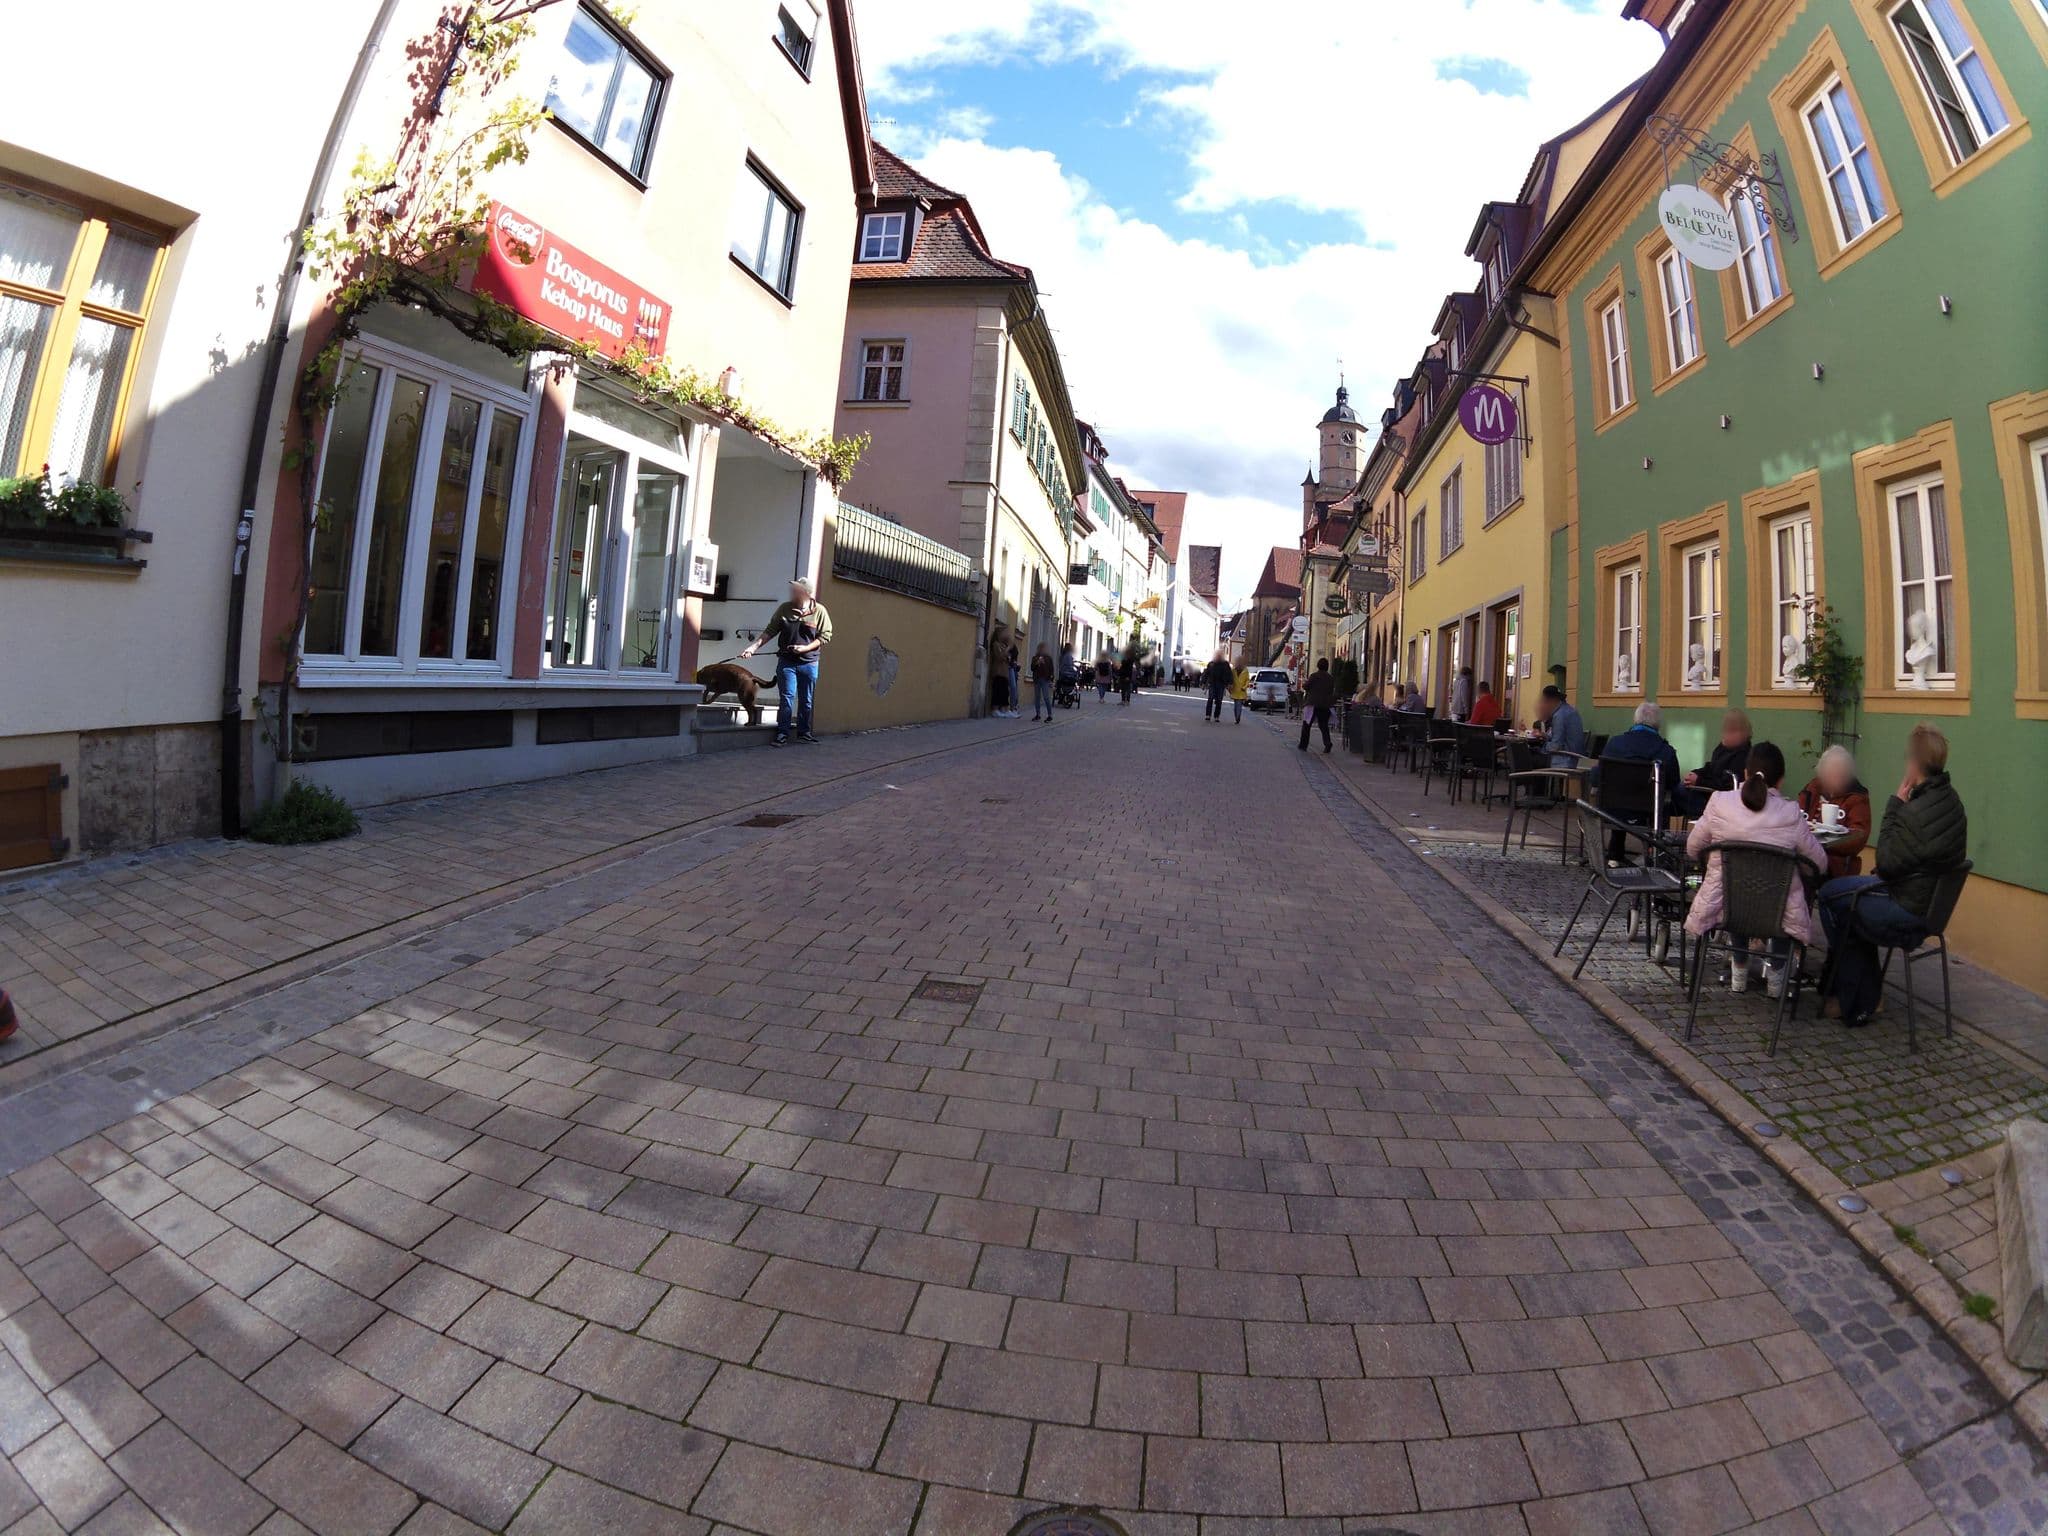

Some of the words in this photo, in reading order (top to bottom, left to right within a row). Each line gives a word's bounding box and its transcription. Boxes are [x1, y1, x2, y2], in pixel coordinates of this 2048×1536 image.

[1693, 207, 1728, 225] HOTEL
[540, 277, 587, 323] Kebap
[588, 303, 624, 338] Haus
[546, 247, 628, 315] Bosporus
